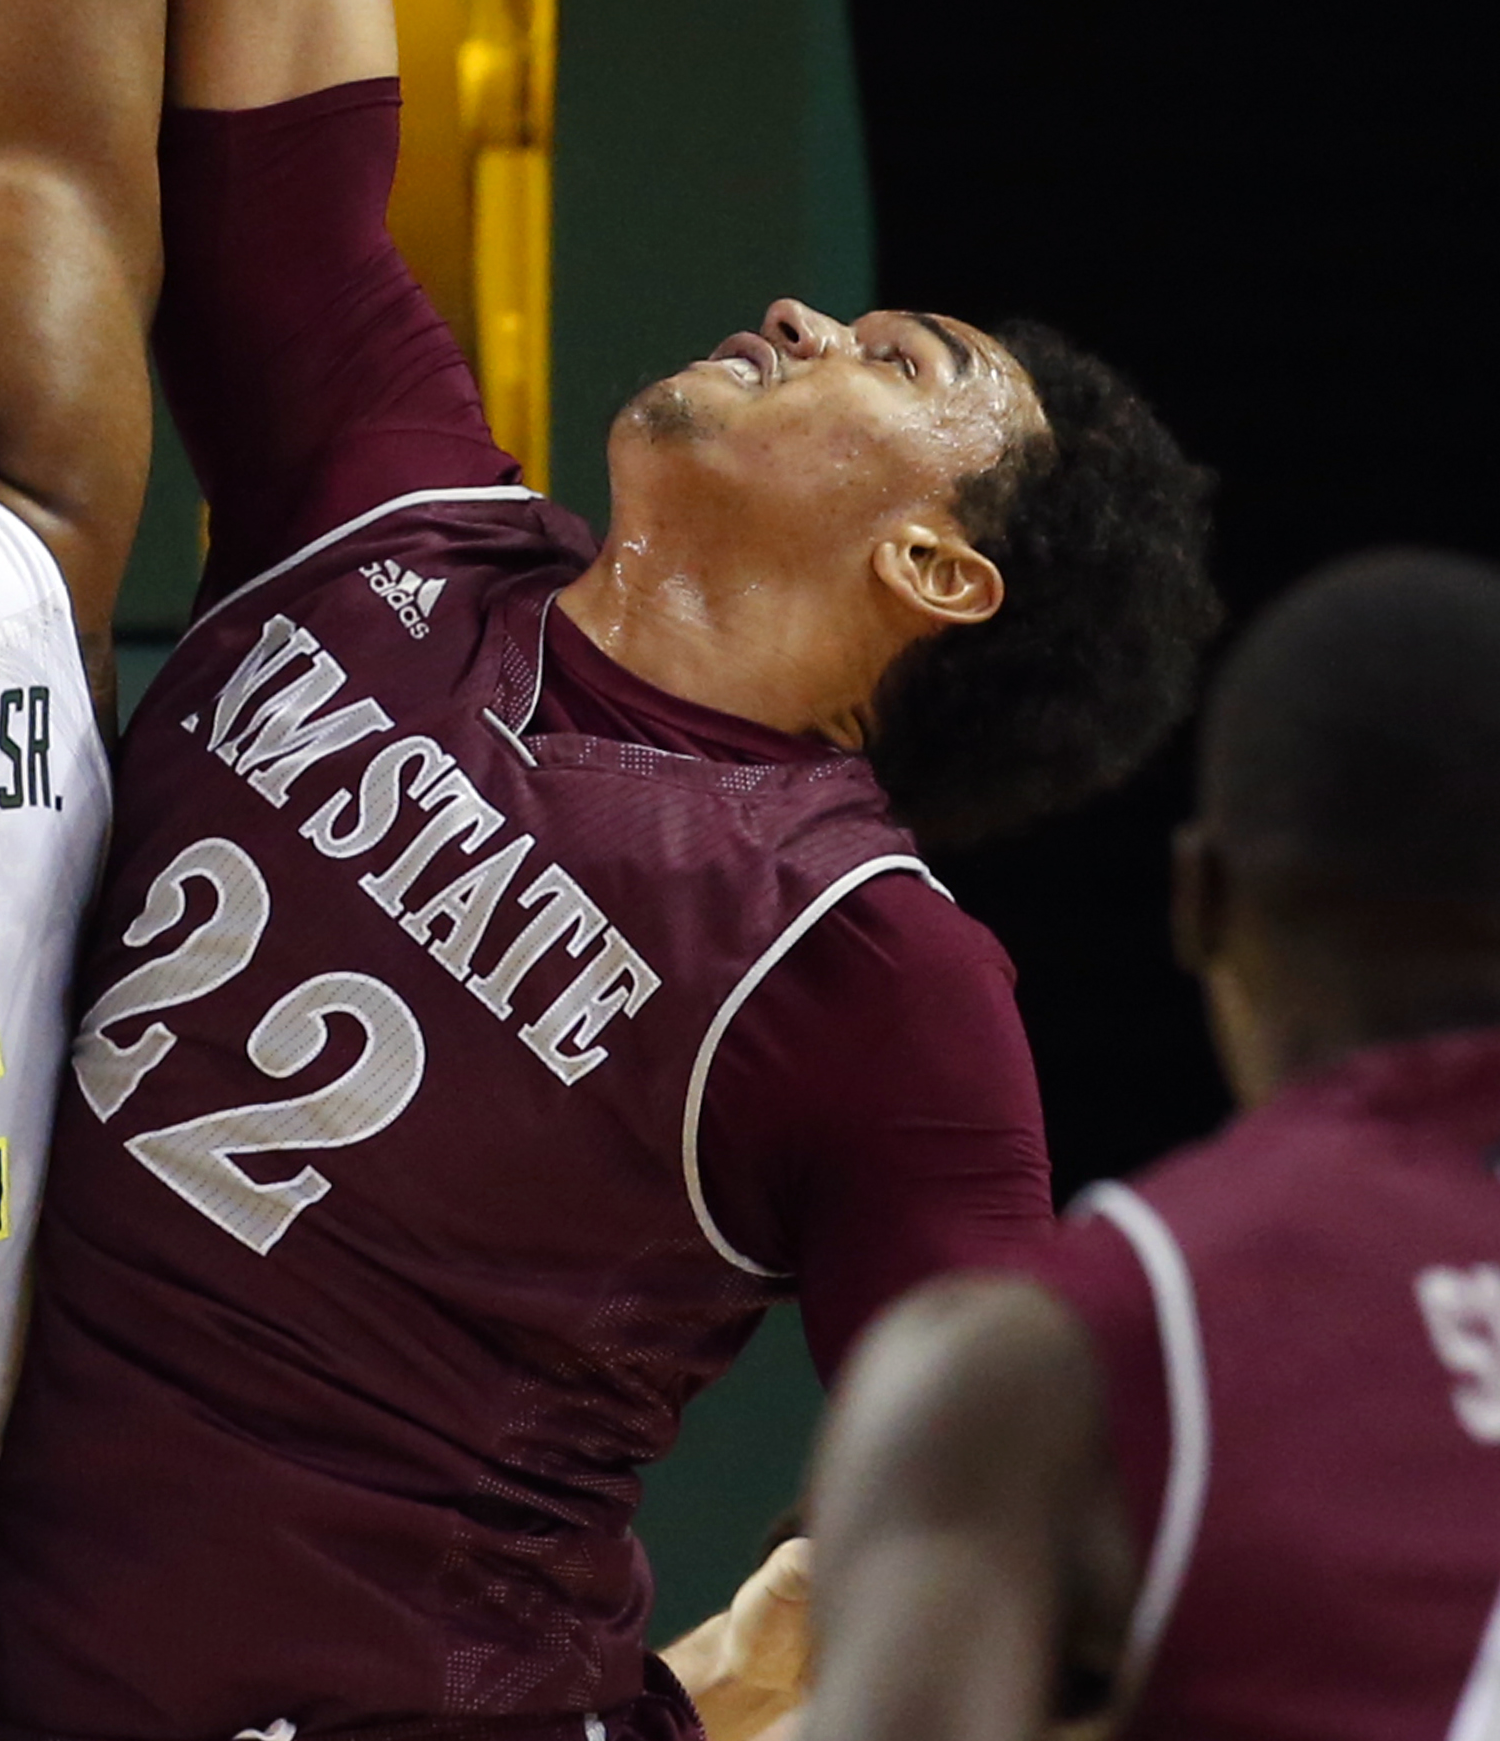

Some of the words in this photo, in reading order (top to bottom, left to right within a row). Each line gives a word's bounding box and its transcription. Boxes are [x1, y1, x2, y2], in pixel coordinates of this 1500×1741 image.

[358, 561, 430, 640] adidas
[71, 837, 426, 1257] 22
[299, 735, 662, 1086] STATE
